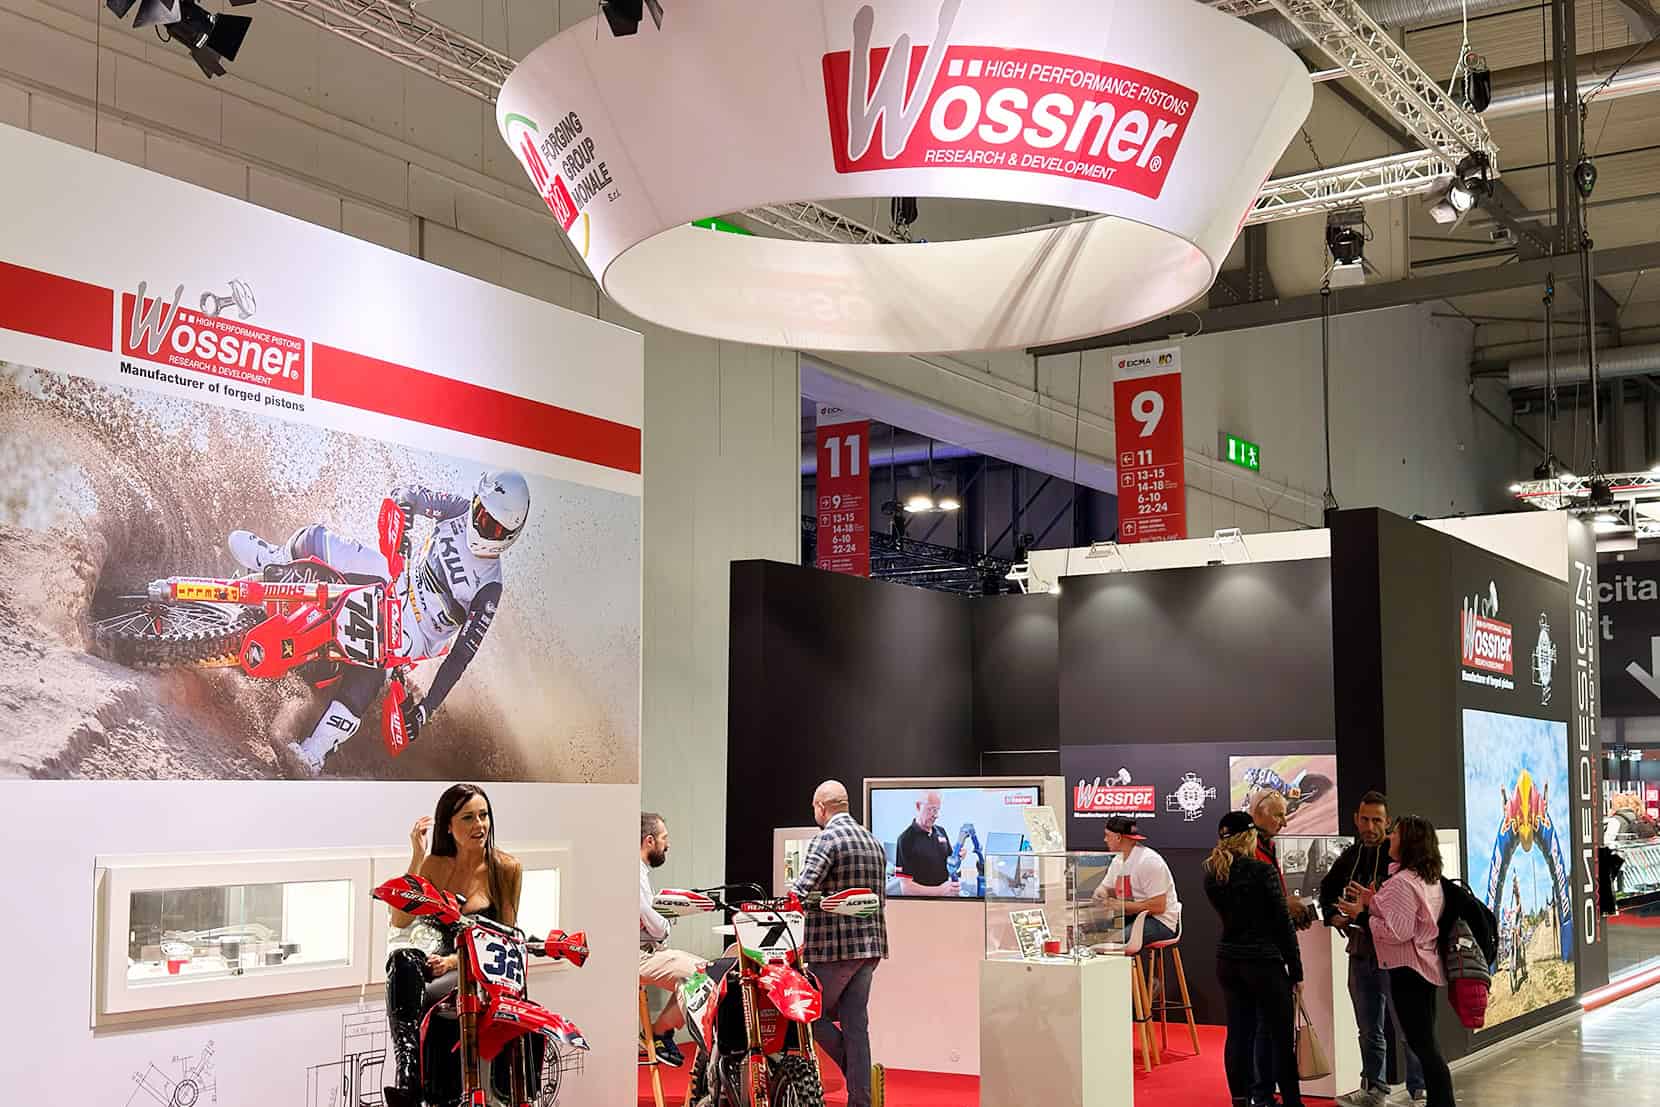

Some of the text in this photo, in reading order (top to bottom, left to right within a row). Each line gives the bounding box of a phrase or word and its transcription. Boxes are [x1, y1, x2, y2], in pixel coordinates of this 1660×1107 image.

[985, 61, 1190, 116] HIGH PERFORMANCE PISTONS
[541, 111, 583, 166] FORGING
[562, 137, 595, 181] GROUP
[924, 149, 1117, 180] RESEARCH & DEVELOPMENT
[571, 162, 613, 210] MONALE
[196, 317, 301, 349] HIGH PERFORMANCE PISTONS
[168, 354, 210, 371] RESEARCH
[218, 366, 272, 385] DEVELOPMENT
[120, 361, 305, 412] Manufacturer of forged pistons
[1131, 390, 1164, 437] 9
[824, 434, 860, 478] 11
[1137, 450, 1153, 465] 11
[1137, 469, 1165, 480] 13-15
[1137, 481, 1164, 492] 14-18
[832, 495, 841, 509] 9
[1138, 493, 1161, 504] 6-10
[1138, 502, 1168, 514] 22-24
[345, 592, 374, 666] 747
[757, 921, 787, 948] 7
[483, 942, 522, 984] 32
